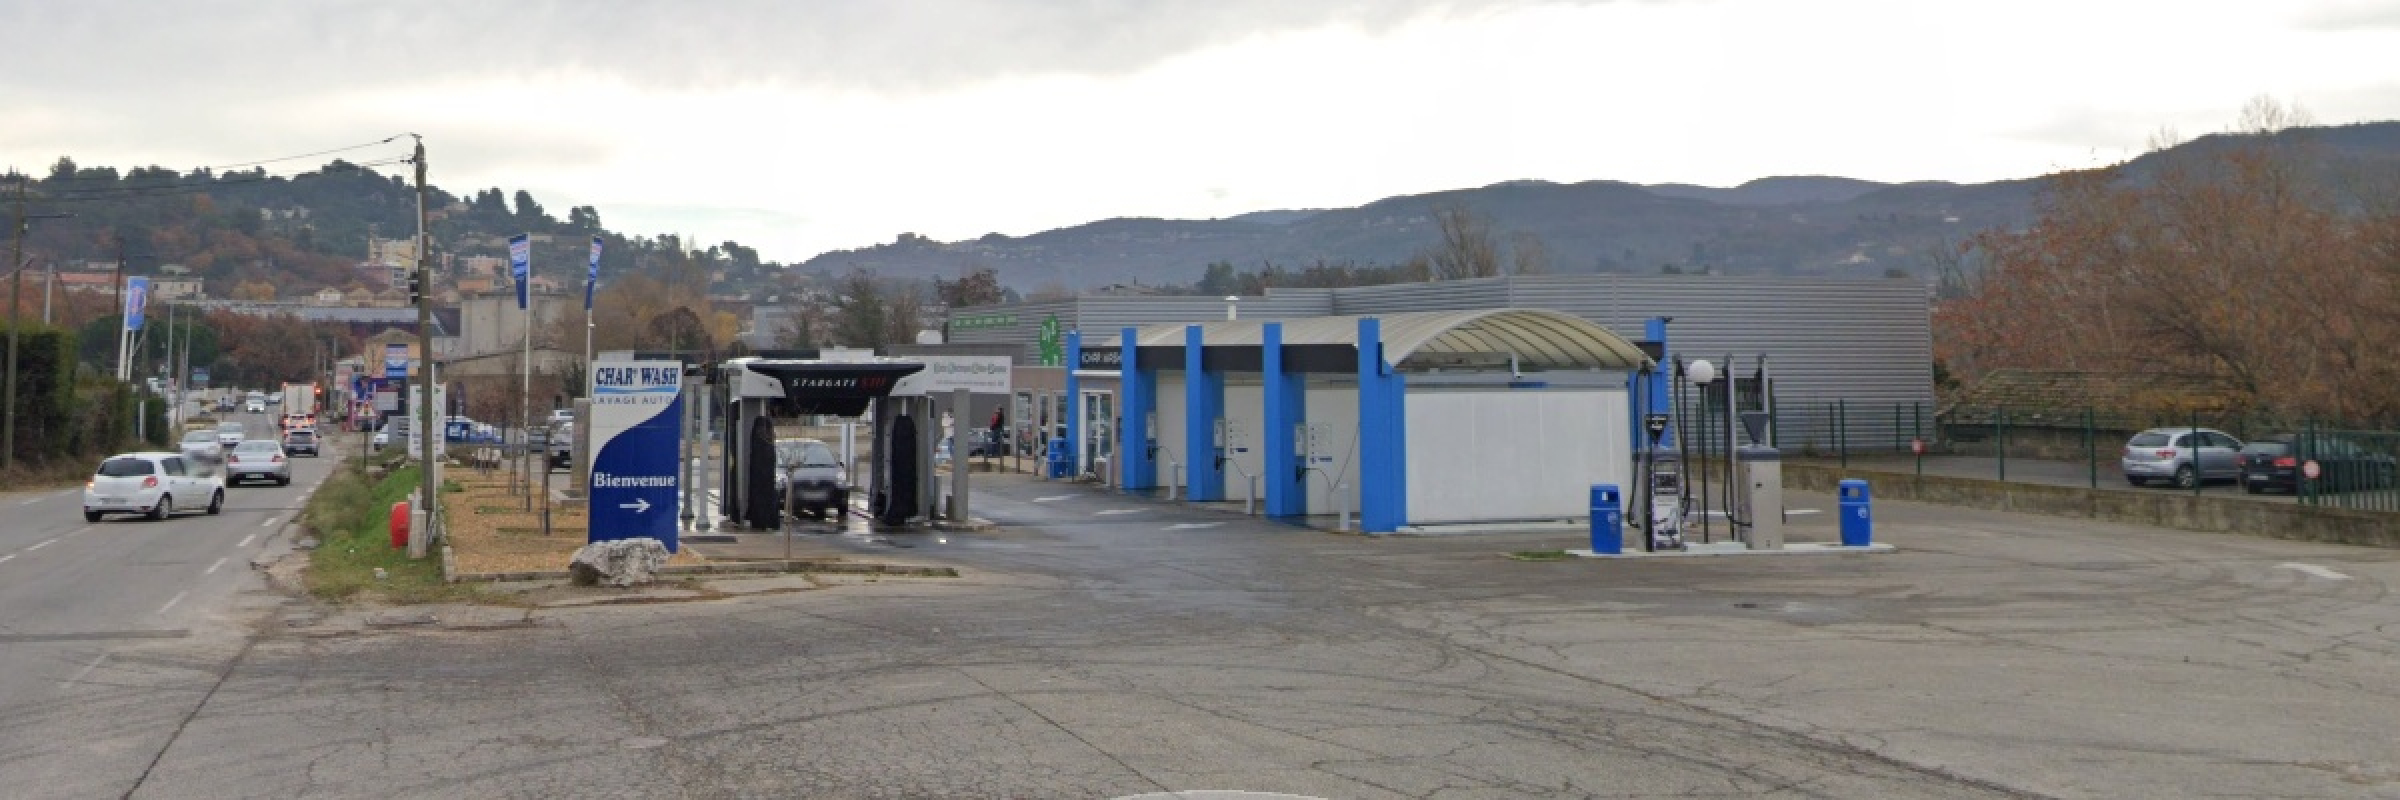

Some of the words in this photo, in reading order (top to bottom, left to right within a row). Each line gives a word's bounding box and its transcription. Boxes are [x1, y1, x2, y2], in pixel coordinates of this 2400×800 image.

[641, 367, 679, 386] WASH
[792, 378, 857, 388] STARGATE
[592, 395, 637, 404] LAVAGE
[641, 395, 674, 404] AUTO
[594, 472, 676, 488] Bienvenue
